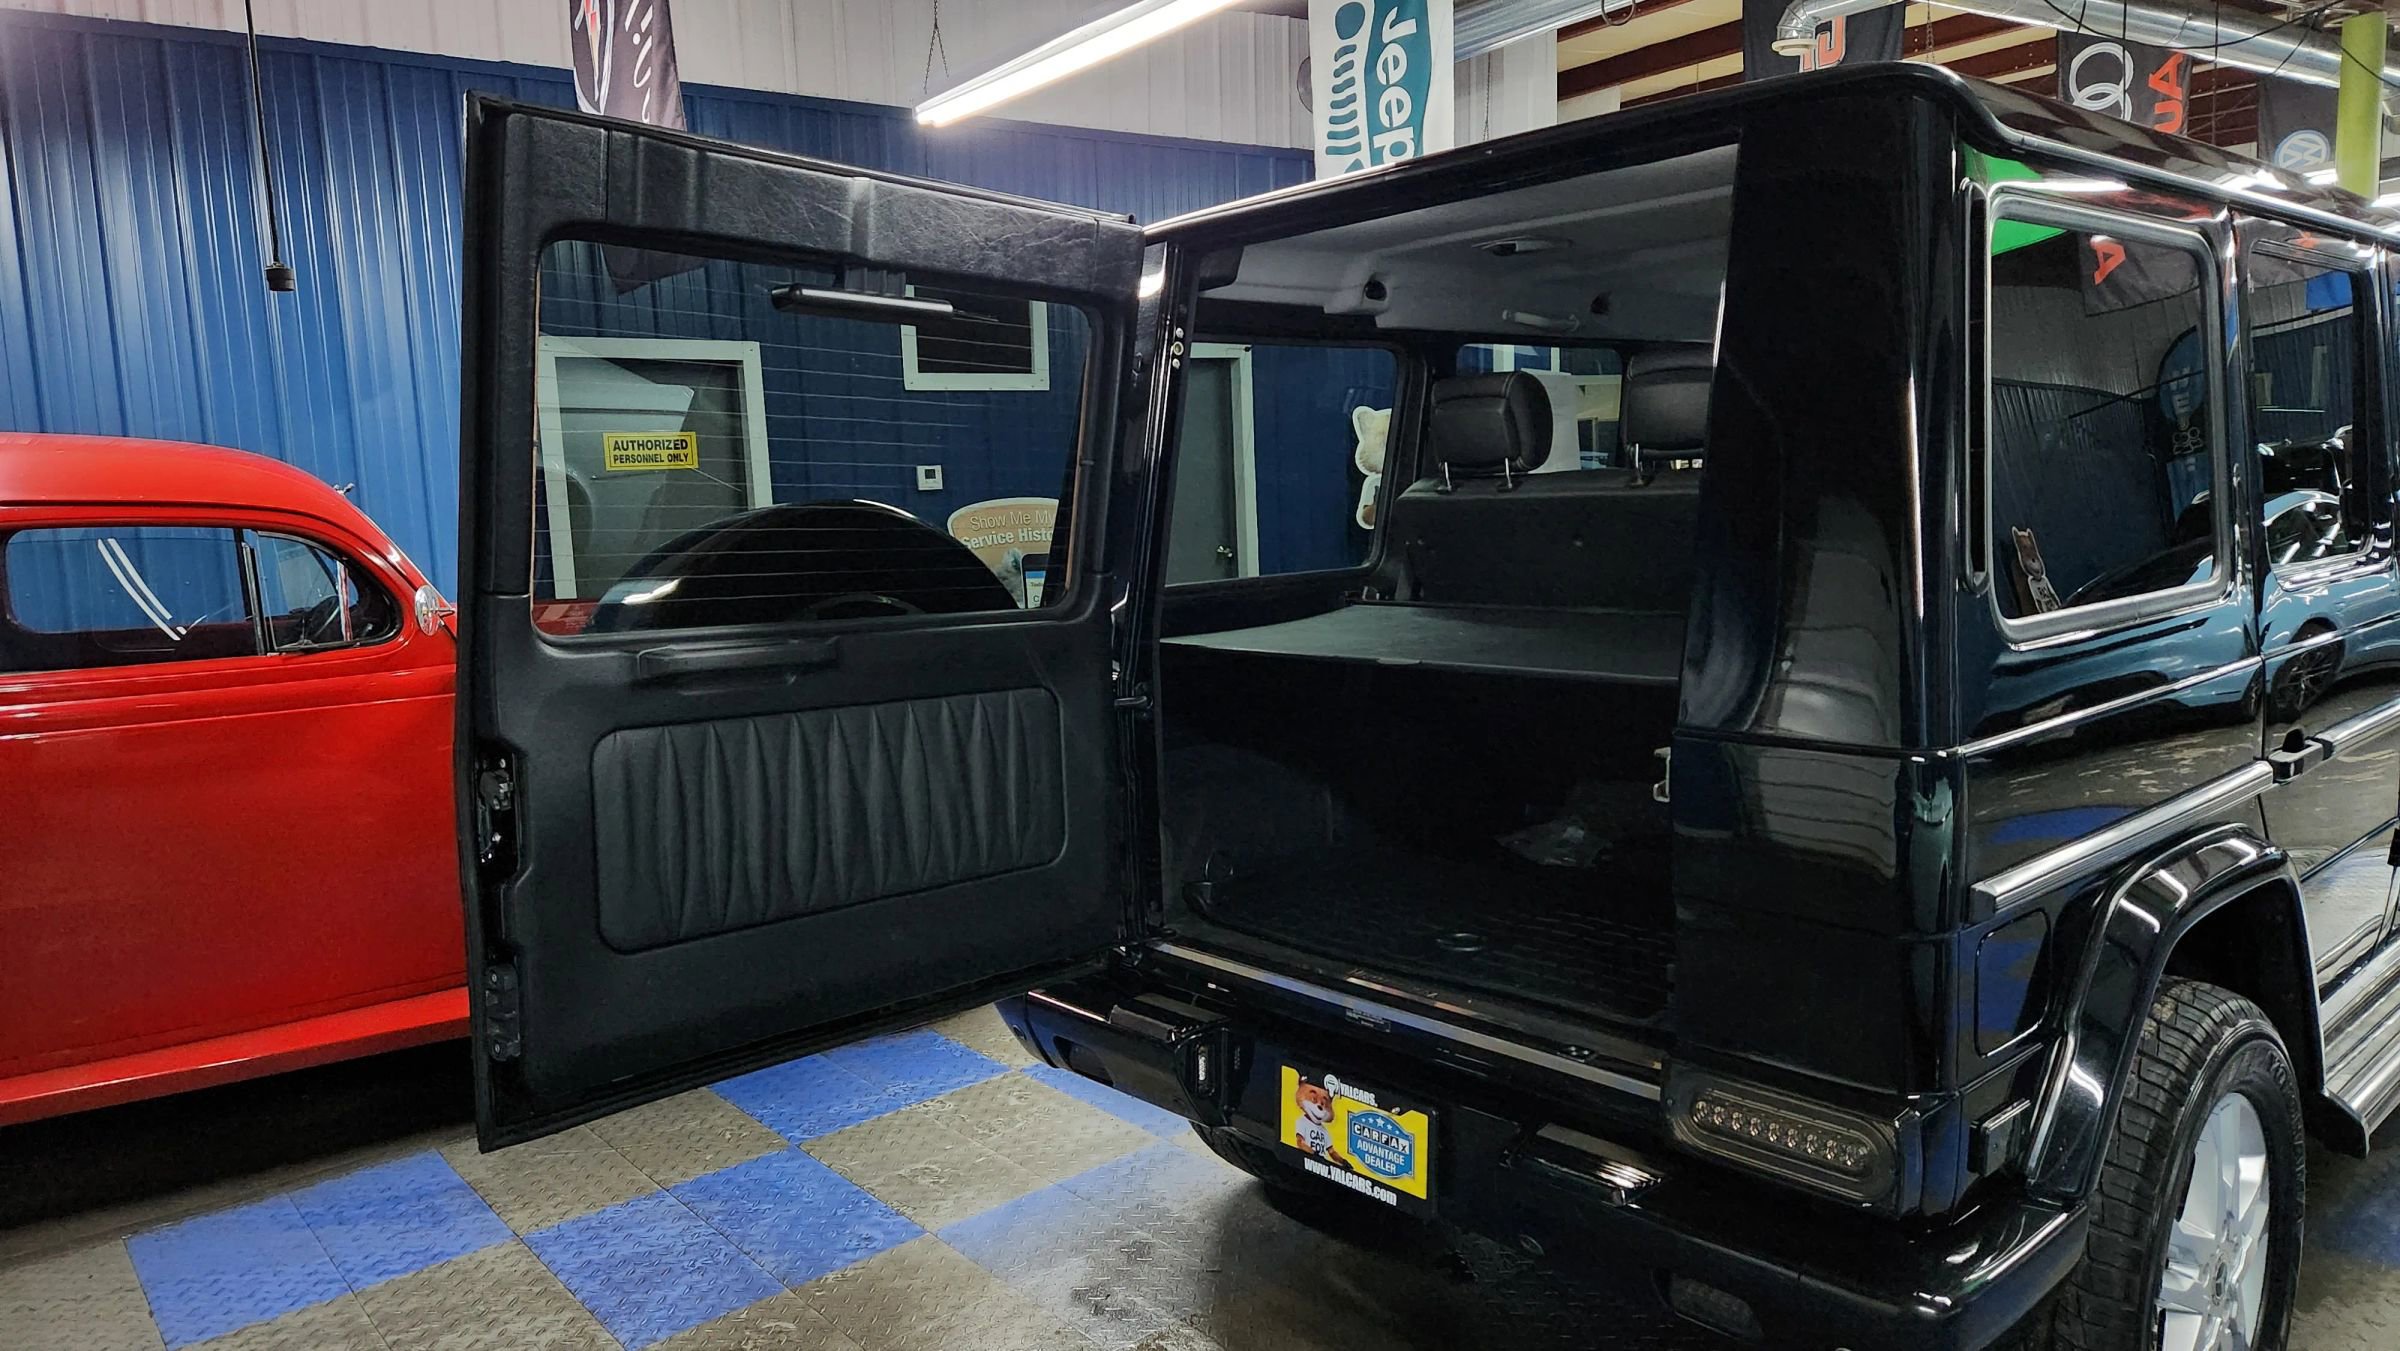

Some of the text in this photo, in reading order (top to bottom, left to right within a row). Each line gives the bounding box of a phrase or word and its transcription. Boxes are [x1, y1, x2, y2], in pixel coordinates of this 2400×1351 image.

[1372, 6, 1417, 164] Jeep
[612, 438, 689, 452] AUTHORIZED
[613, 452, 689, 465] PERSONNEL ONLY
[970, 510, 1055, 531] Show Me My
[1354, 1122, 1409, 1154] CARFAX
[1356, 1139, 1405, 1166] ADVANTAGE
[1364, 1153, 1397, 1174] DEALER
